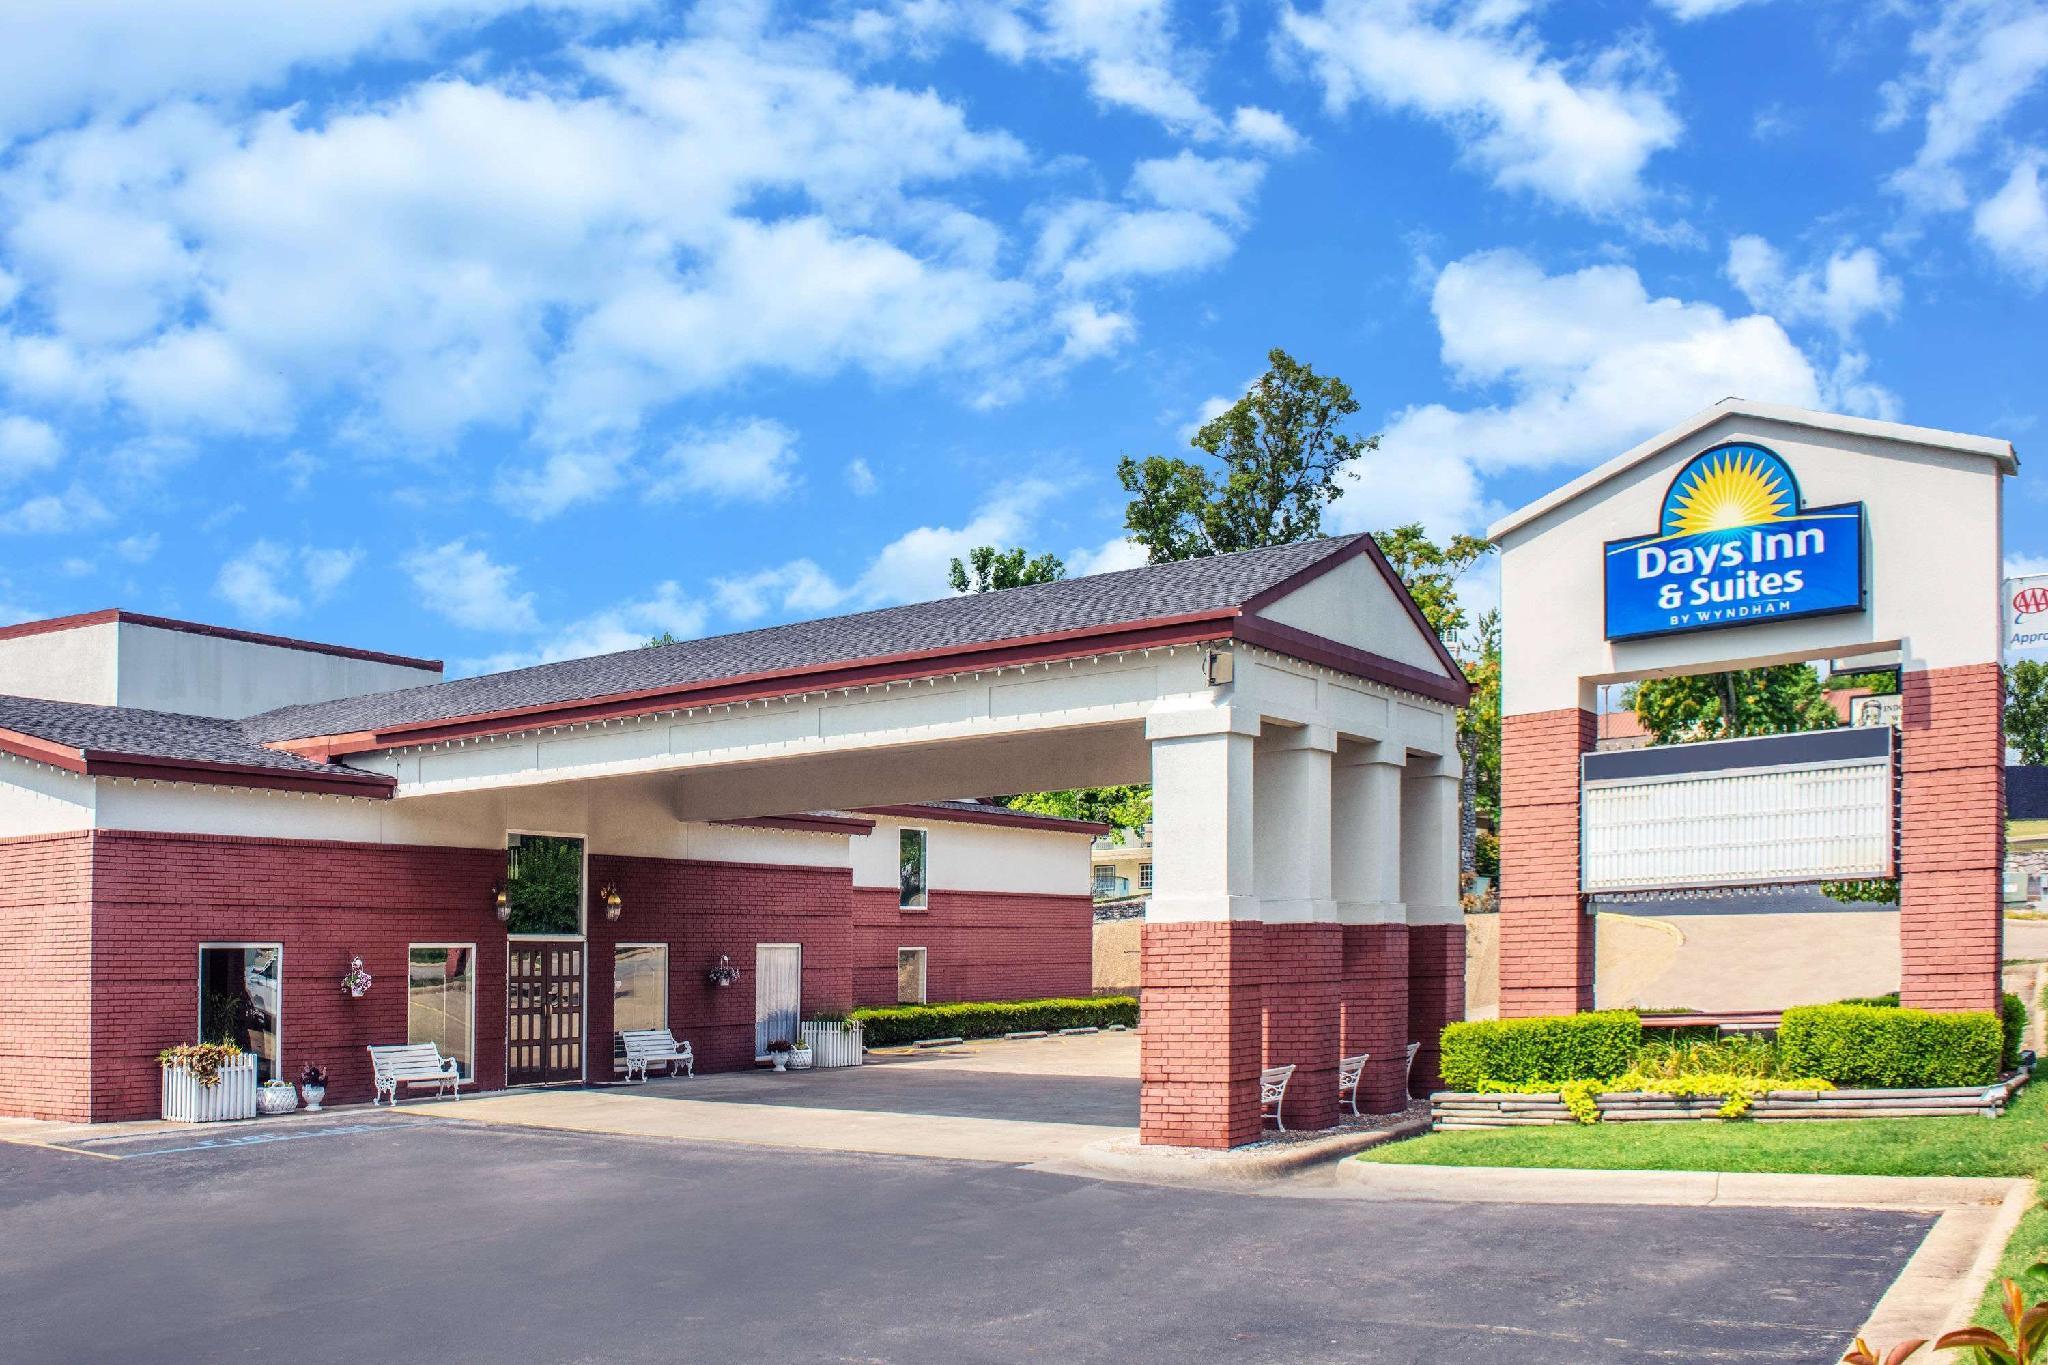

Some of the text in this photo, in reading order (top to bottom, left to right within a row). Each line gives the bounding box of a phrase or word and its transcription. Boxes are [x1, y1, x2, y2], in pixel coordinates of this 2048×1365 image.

[1637, 528, 1825, 579] Days Inn
[1658, 569, 1803, 609] & Suites
[2014, 588, 2048, 613] AAA
[1670, 601, 1790, 625] BY WYNDHAM
